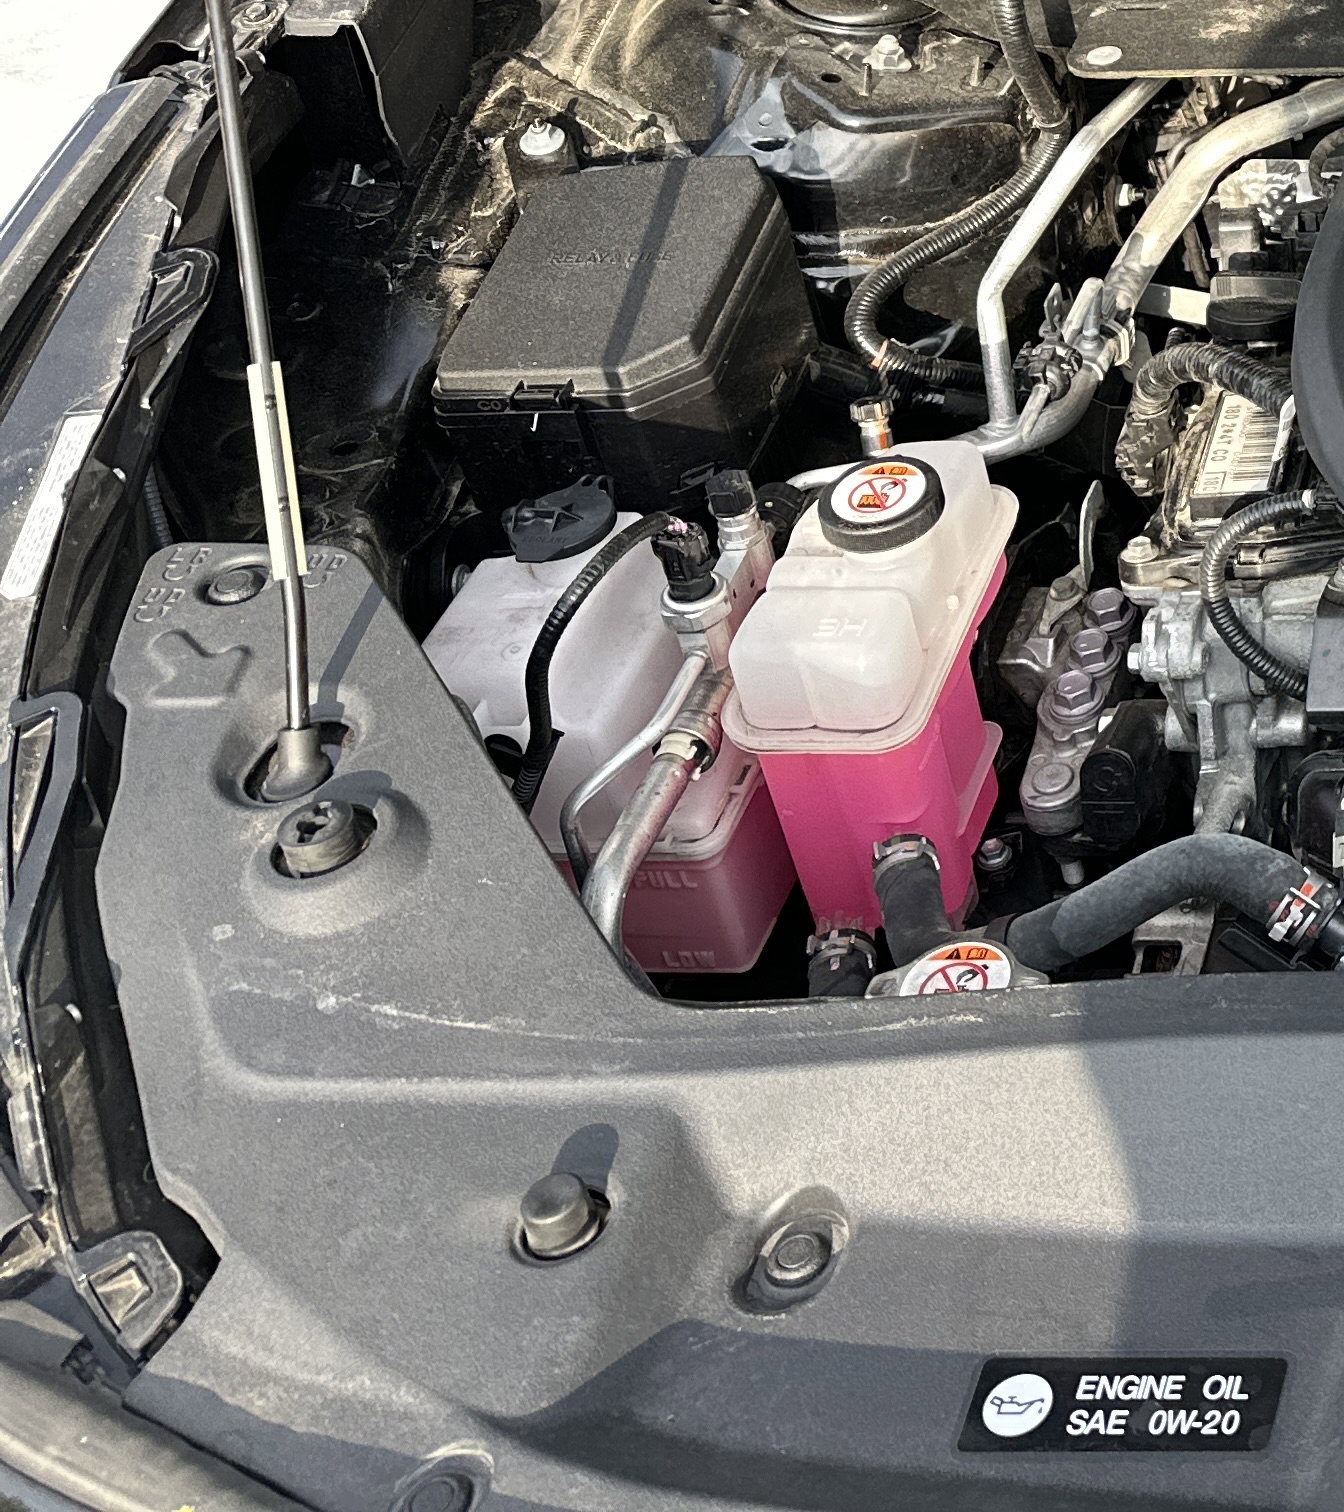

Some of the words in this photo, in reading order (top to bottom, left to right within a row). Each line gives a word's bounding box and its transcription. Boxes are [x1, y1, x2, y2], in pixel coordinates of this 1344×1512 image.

[634, 870, 699, 889] FULL
[661, 951, 716, 968] LOW
[1074, 1374, 1186, 1401] ENGINE
[1202, 1374, 1250, 1401] OIL
[1065, 1409, 1130, 1436] SAE
[1147, 1409, 1241, 1436] 0W-20
